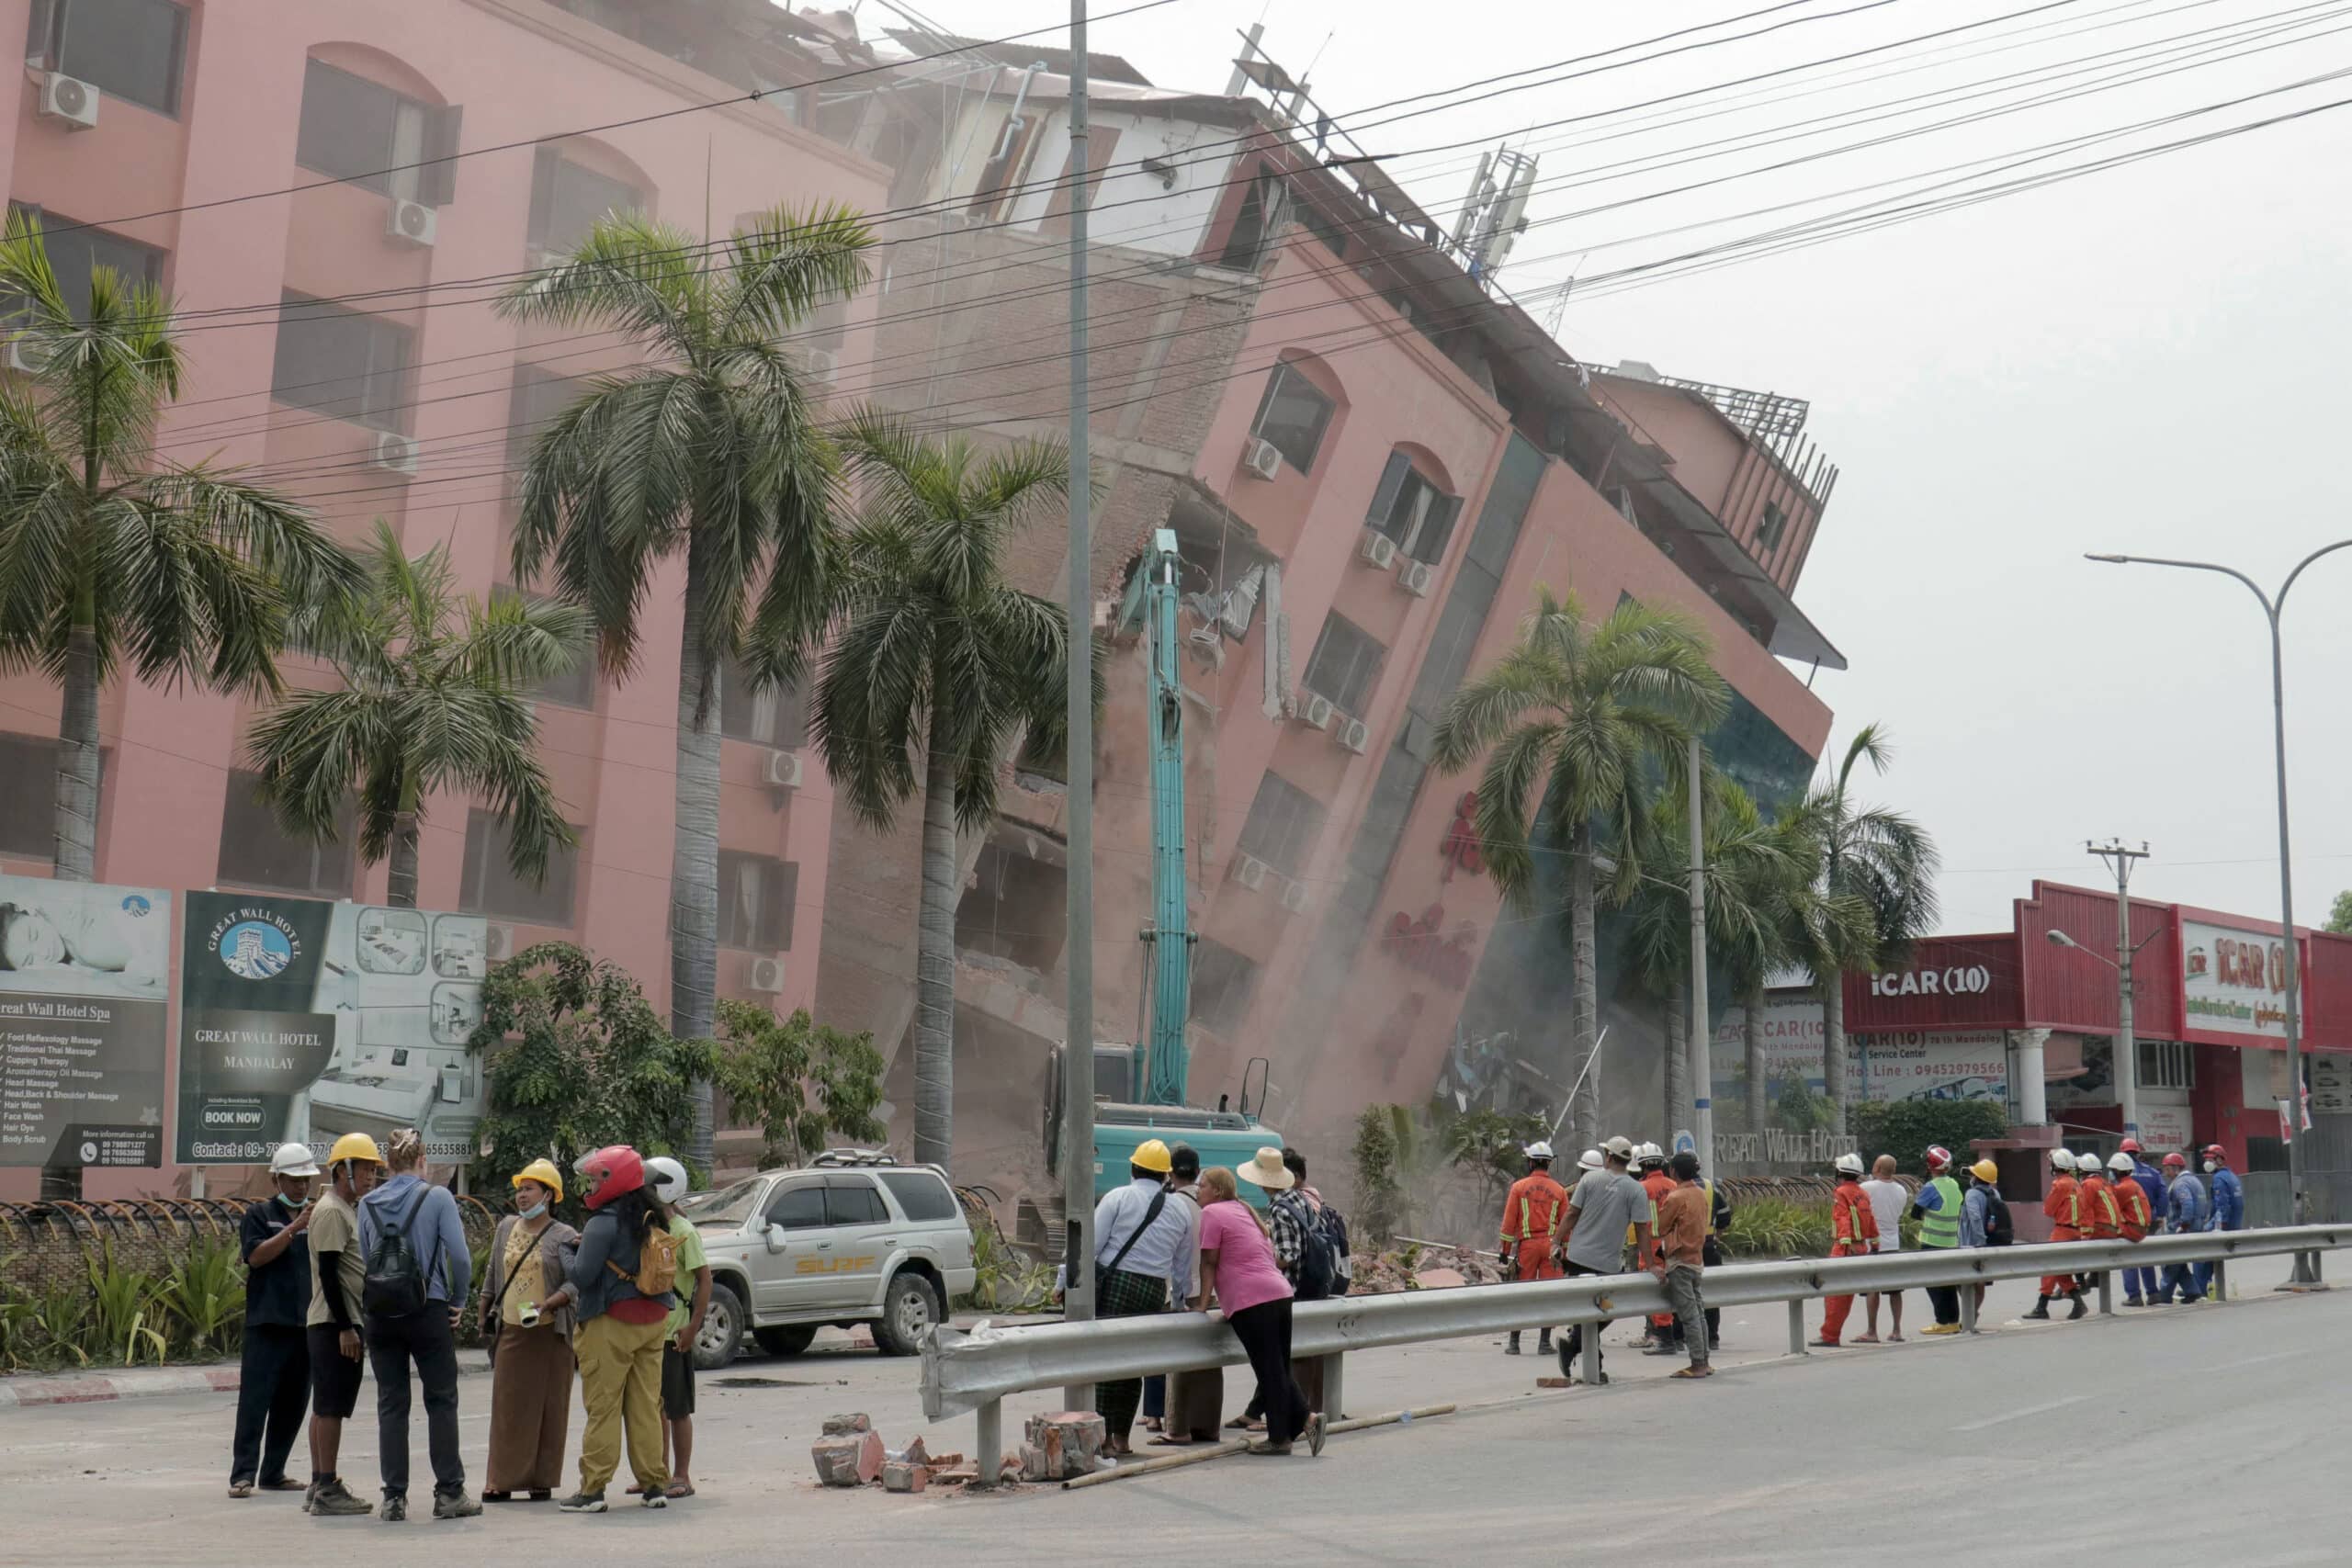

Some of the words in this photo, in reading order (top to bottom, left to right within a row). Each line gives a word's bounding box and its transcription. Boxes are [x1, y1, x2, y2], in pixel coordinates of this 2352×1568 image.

[208, 911, 238, 952] GREAT
[240, 908, 273, 921] WALL
[275, 915, 302, 960] HOTEL
[2216, 938, 2266, 989] iCAR
[1871, 971, 1939, 997] iCAR
[1943, 964, 1990, 996] (10)
[0, 1004, 24, 1014] reat
[28, 1002, 53, 1016] Wall
[57, 1004, 88, 1018] Hotel
[89, 1007, 111, 1021] Spa
[7, 1033, 25, 1042] Foot
[71, 1037, 103, 1046] Massage
[195, 1029, 239, 1043] GREAT
[241, 1031, 277, 1045] WALL
[279, 1032, 322, 1047] HOTEL
[7, 1044, 46, 1054] Traditional
[64, 1048, 96, 1056] Massage
[1868, 1050, 1898, 1060] Service
[1899, 1049, 1927, 1059] Center
[6, 1056, 38, 1066] Cupping
[40, 1058, 69, 1067] Therapy
[223, 1056, 295, 1070] MANDALAY
[6, 1067, 58, 1078] Aromatherapy
[60, 1069, 71, 1077] Oil
[71, 1071, 103, 1079] Massage
[1873, 1065, 1902, 1077] Line
[1915, 1062, 2005, 1076] 09452979566
[26, 1079, 59, 1089] Massage
[87, 1093, 119, 1101] Massage
[4, 1101, 20, 1110] Hair
[21, 1101, 42, 1110] Wash
[4, 1112, 23, 1121] Face
[23, 1112, 44, 1121] Wash
[205, 1112, 234, 1123] BOOK
[236, 1112, 262, 1124] NOW
[19, 1124, 35, 1134] Dye
[100, 1131, 135, 1139] information
[3, 1135, 22, 1144] Body
[193, 1143, 236, 1156] Contact
[244, 1143, 265, 1156] 09-
[1714, 1134, 1757, 1161] REAT
[796, 1257, 875, 1273] SURF
